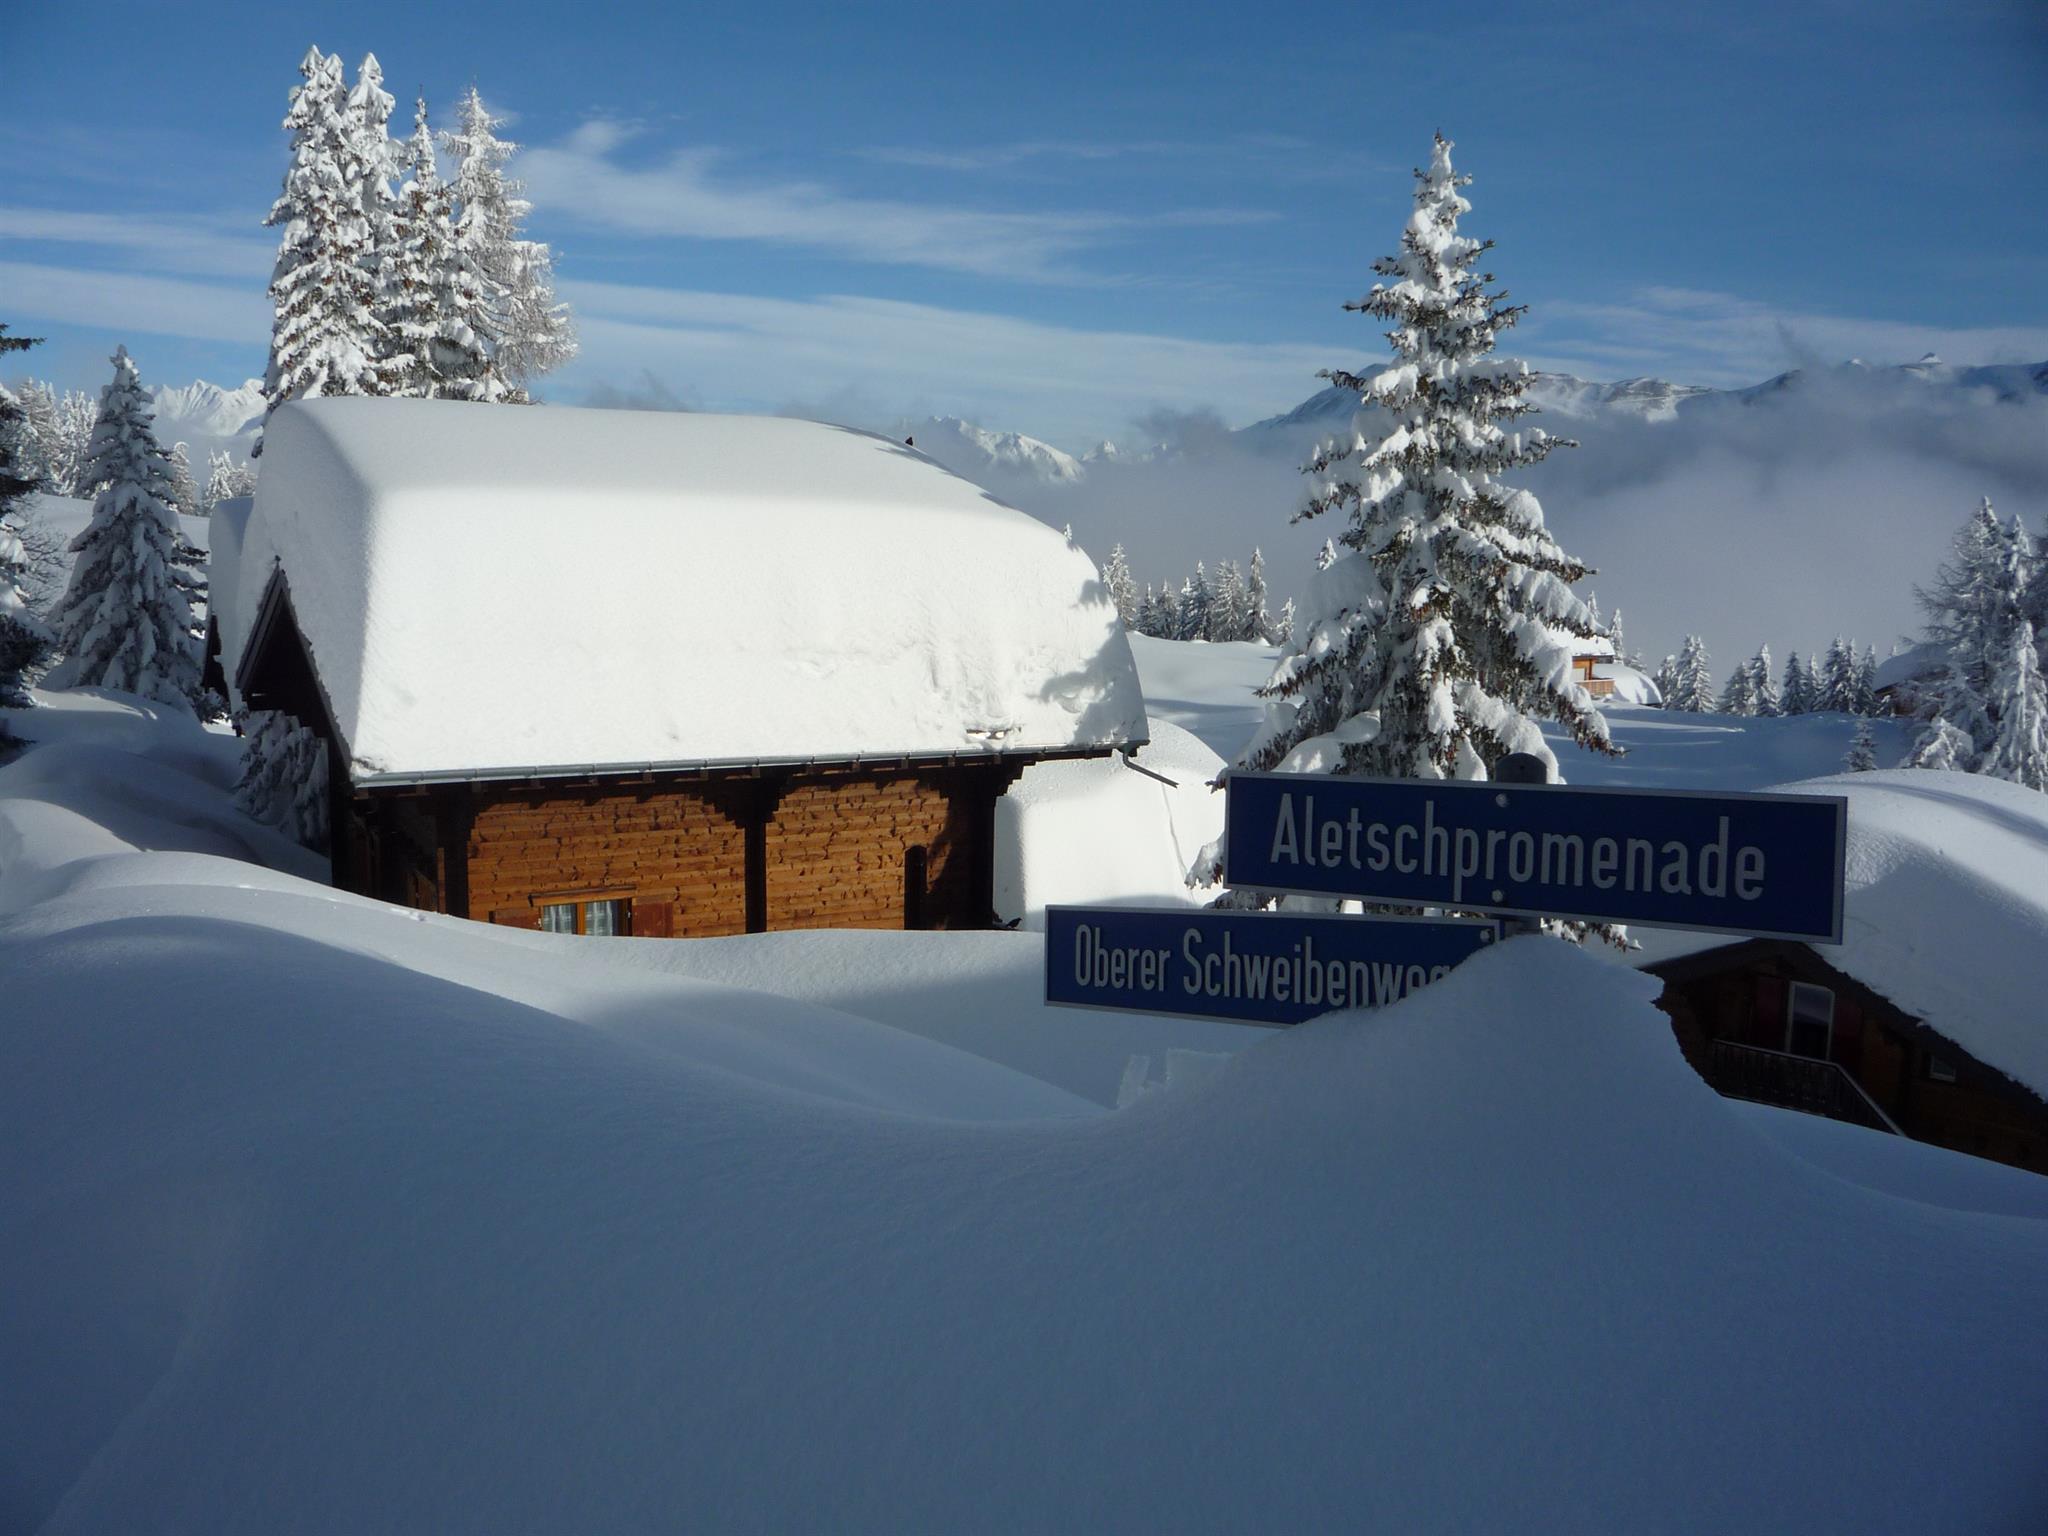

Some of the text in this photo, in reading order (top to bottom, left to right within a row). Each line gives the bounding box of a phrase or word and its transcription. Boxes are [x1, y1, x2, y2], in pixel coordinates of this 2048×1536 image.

[1270, 792, 1766, 902] Aletschpromenade
[1074, 923, 1450, 1009] Oberer Schweibenwe
